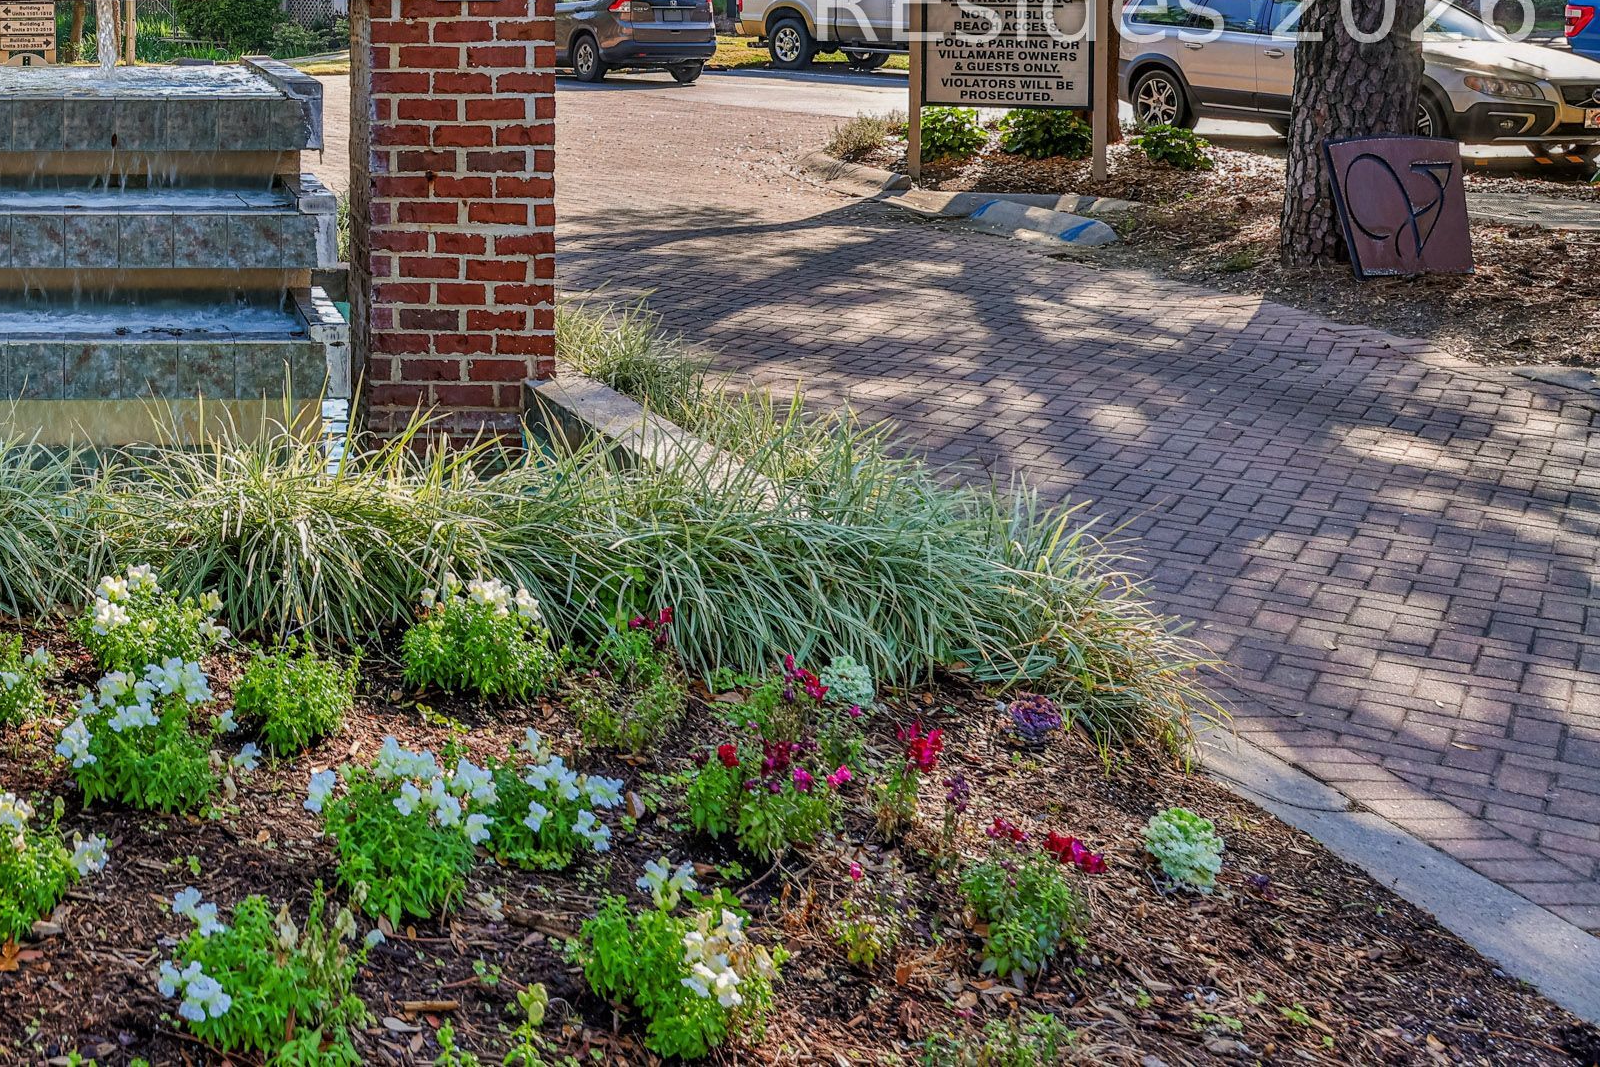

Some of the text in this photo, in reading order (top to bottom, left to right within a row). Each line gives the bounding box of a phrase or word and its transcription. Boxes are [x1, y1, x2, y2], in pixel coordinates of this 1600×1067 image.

[961, 10, 1055, 21] NOT A PUBLIC
[953, 21, 1062, 33] BEACH ACCESS.
[935, 38, 1080, 50] POOL & PARKING FOR
[938, 50, 1078, 62] VILLAMARE OWNERS
[954, 62, 1061, 73] & GUESTS ONLY.
[941, 78, 1074, 91] VIOLATORS WILL BE
[960, 90, 1054, 102] PROSECUTED.
